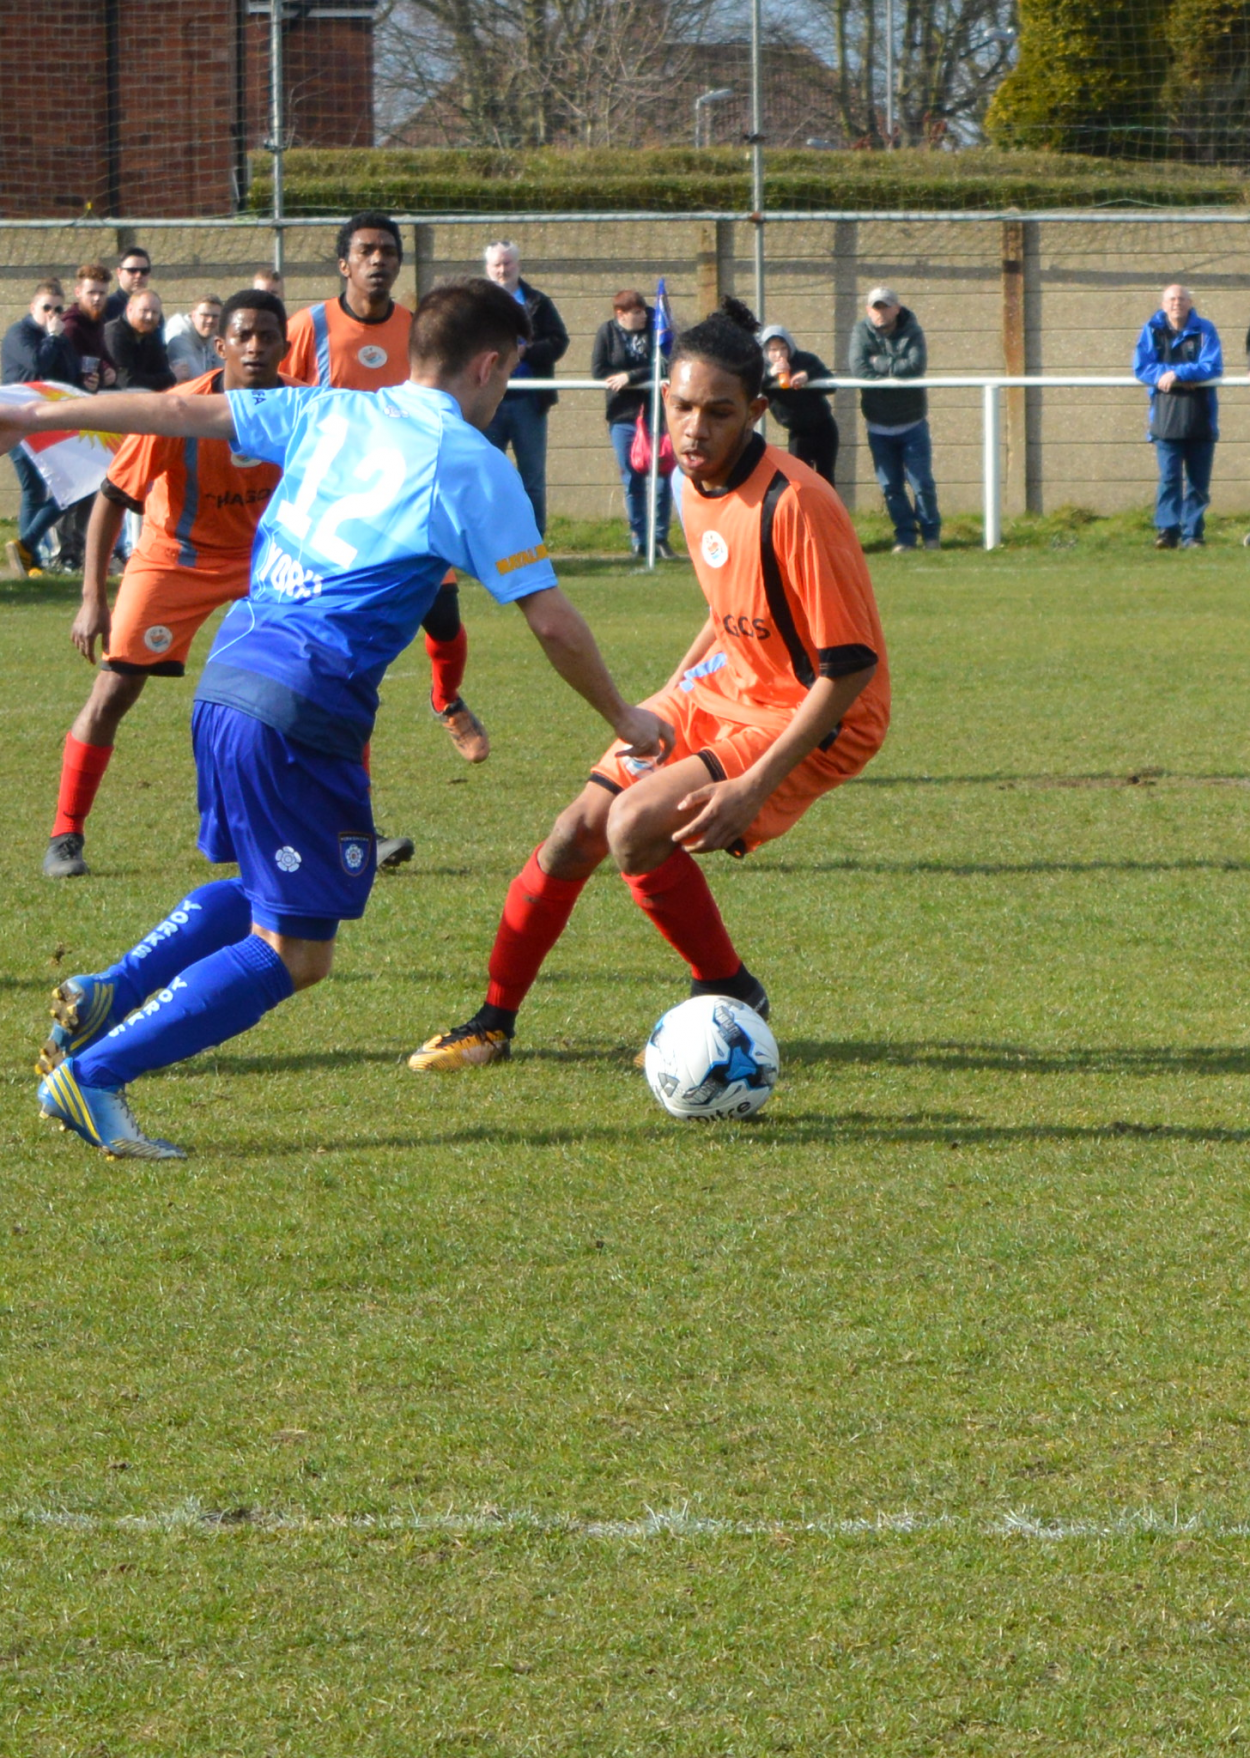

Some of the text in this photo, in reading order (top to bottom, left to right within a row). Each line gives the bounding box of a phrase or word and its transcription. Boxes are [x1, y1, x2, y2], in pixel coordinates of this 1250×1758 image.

[275, 413, 407, 570] 12
[108, 975, 188, 1038] YORKS
[687, 1101, 751, 1122] mitre
